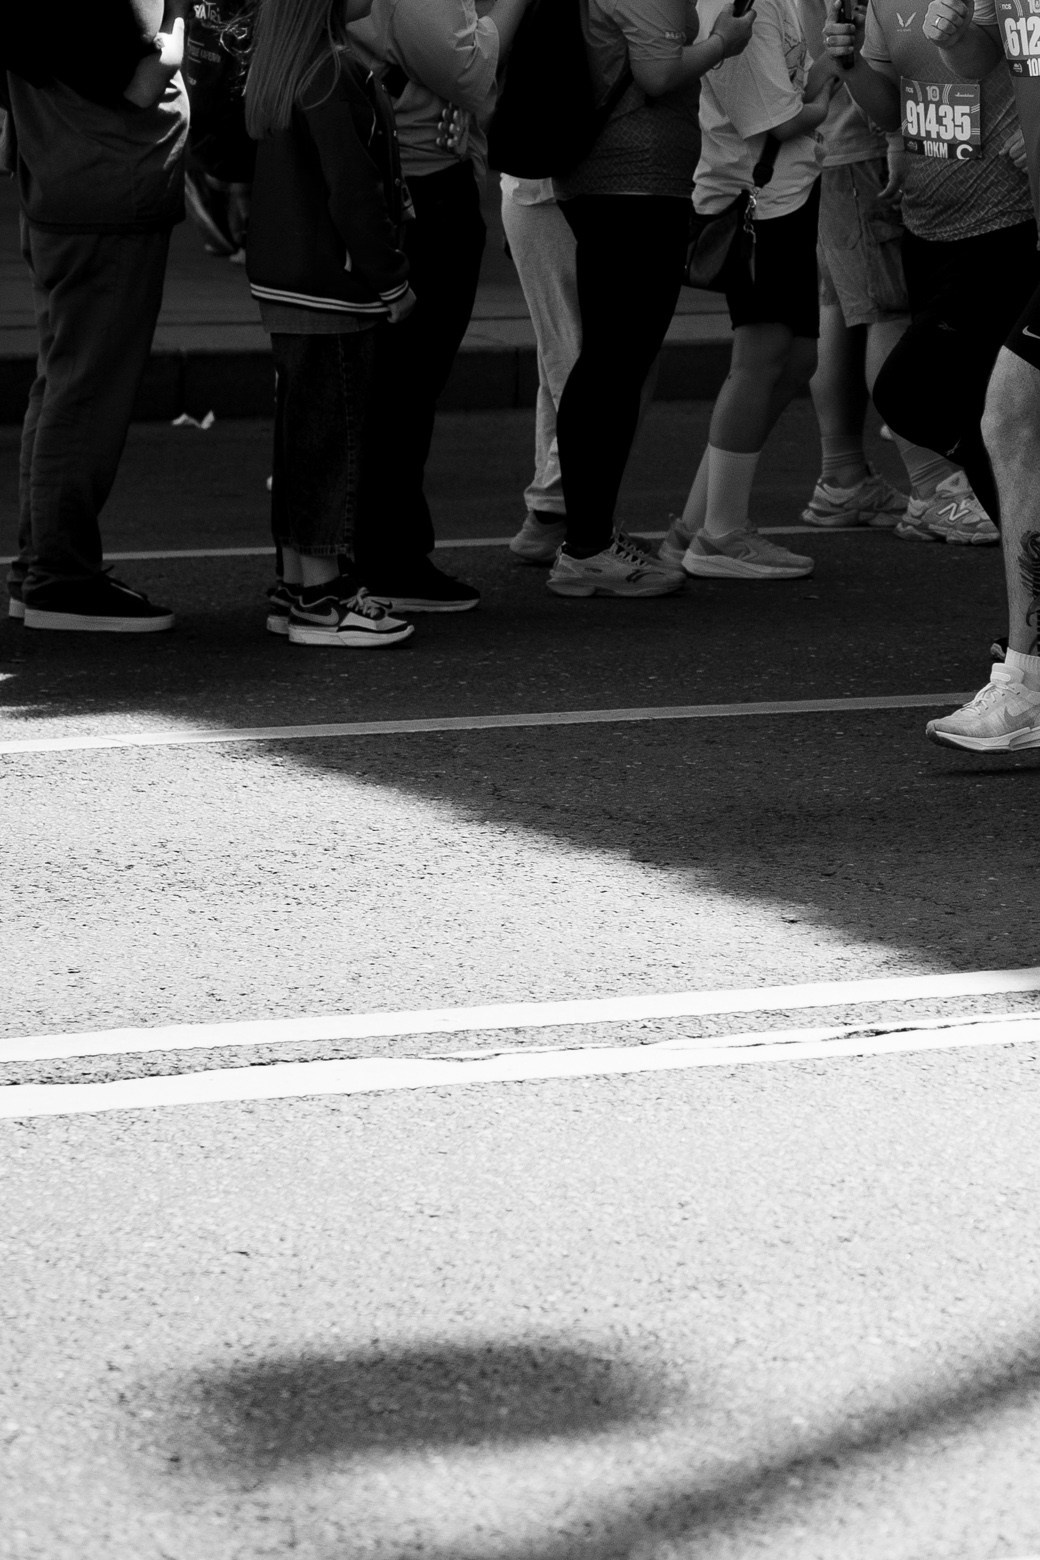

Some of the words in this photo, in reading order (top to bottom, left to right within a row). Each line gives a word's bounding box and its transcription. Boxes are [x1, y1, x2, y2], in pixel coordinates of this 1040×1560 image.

[926, 85, 940, 101] 10
[906, 99, 971, 141] 91435
[923, 140, 949, 159] 10KM
[956, 143, 974, 160] C
